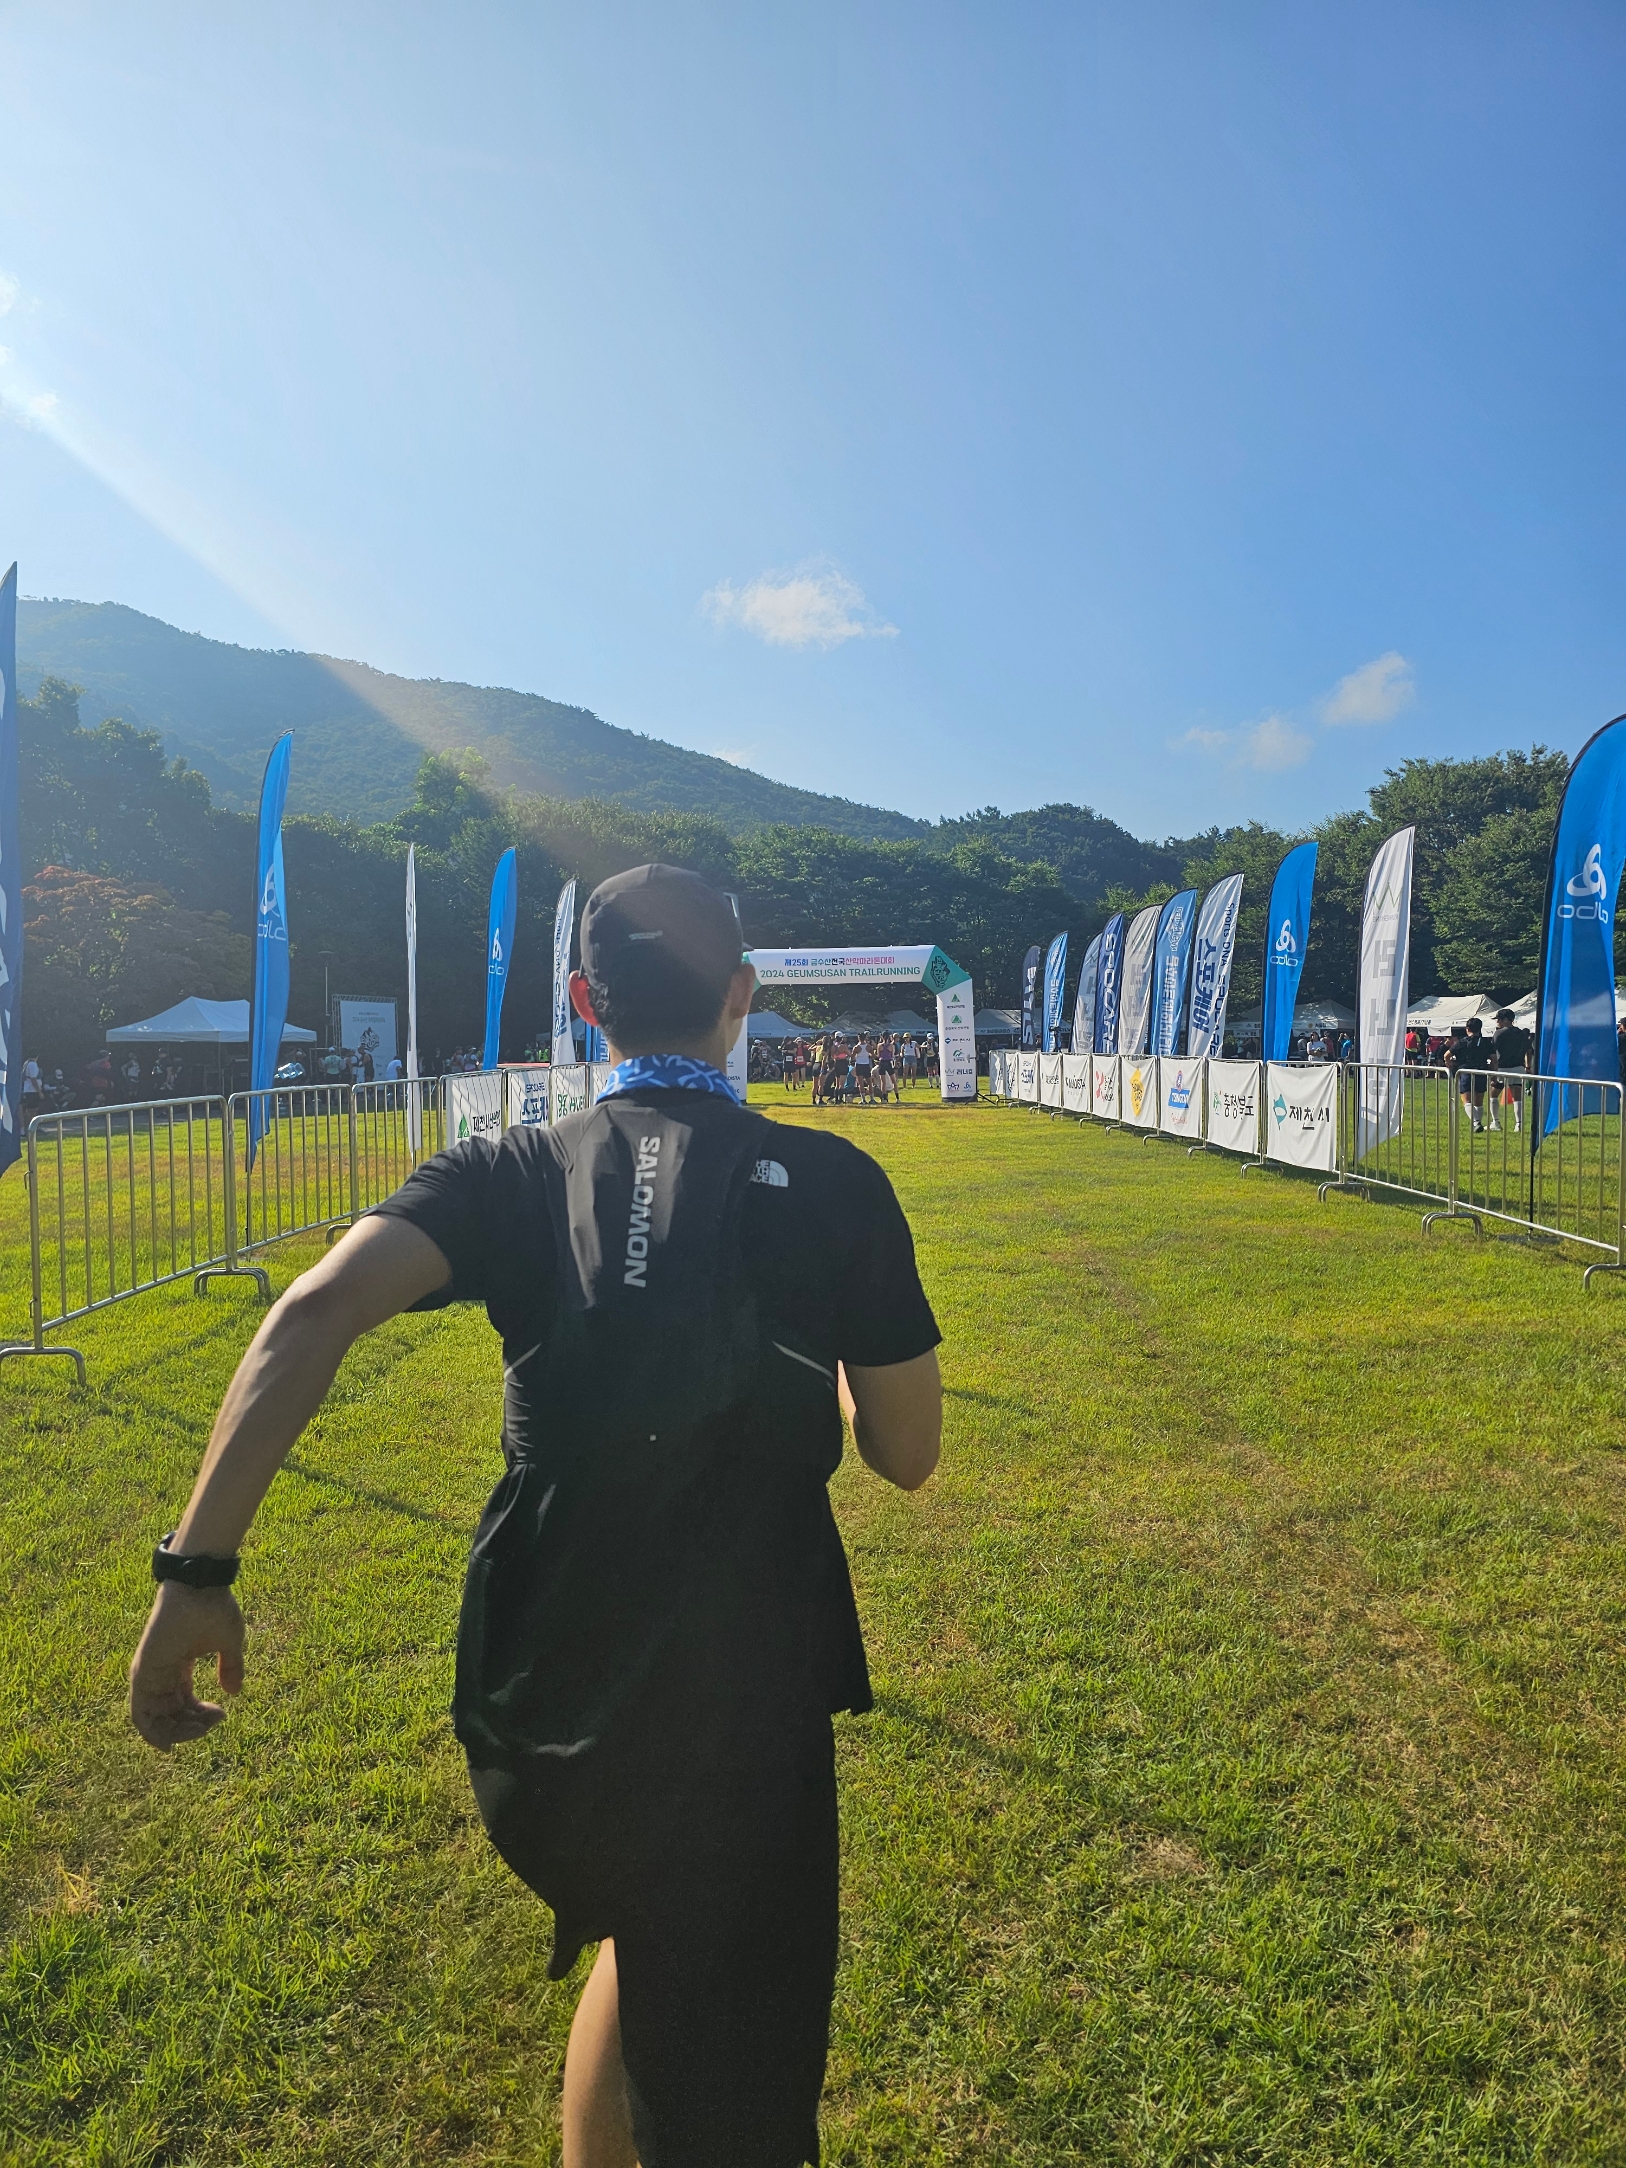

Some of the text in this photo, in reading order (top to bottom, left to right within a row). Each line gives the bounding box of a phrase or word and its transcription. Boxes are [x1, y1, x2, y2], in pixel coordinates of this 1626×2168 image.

[1556, 901, 1609, 925] odlo
[1220, 941, 1231, 967] DNA
[760, 966, 921, 978] 2024 GEUMSUSAN TRAILRUNNING
[1192, 938, 1217, 1034] 스포케어
[1223, 1092, 1255, 1120] 충청북도
[1288, 1105, 1331, 1131] 제천시
[623, 1136, 661, 1288] SALOMON
